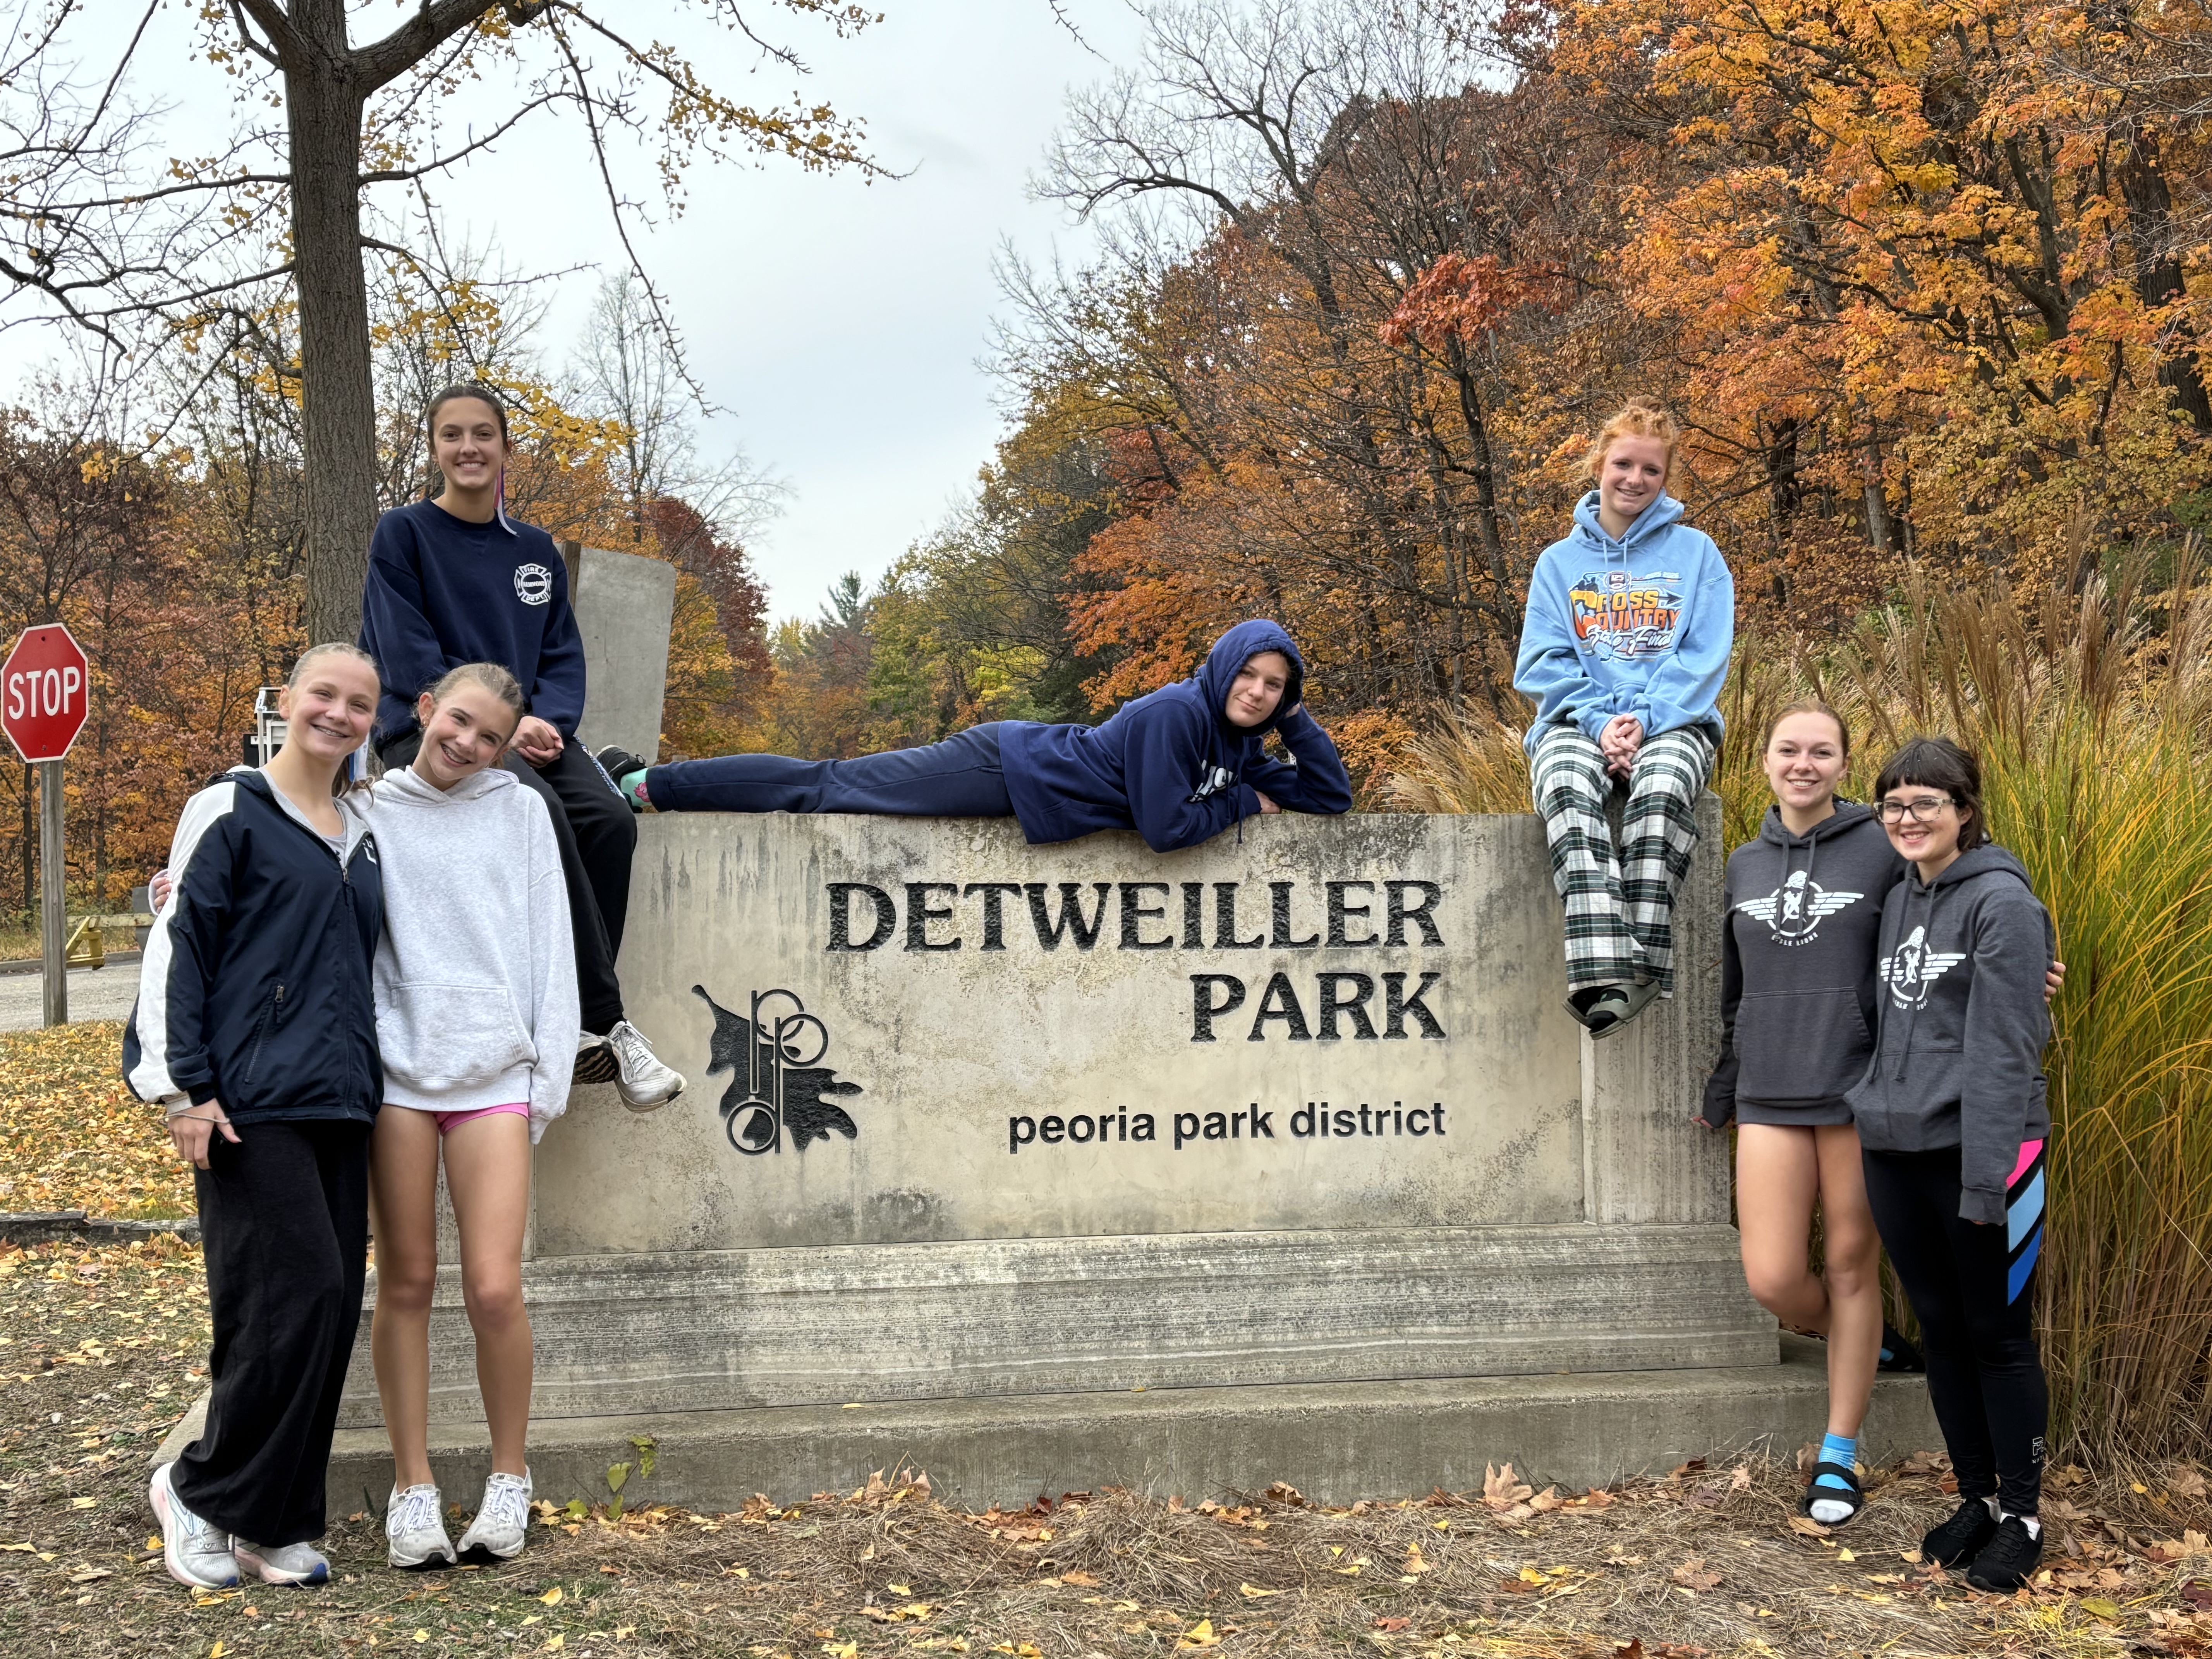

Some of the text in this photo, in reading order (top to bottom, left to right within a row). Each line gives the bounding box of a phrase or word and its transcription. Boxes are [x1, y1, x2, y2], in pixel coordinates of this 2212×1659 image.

[8, 666, 80, 720] STOP
[825, 881, 1445, 952] DETWEILLER
[1771, 933, 1793, 946] LSLE
[1189, 972, 1447, 1042] PARK
[1009, 1101, 1445, 1154] peoria park district
